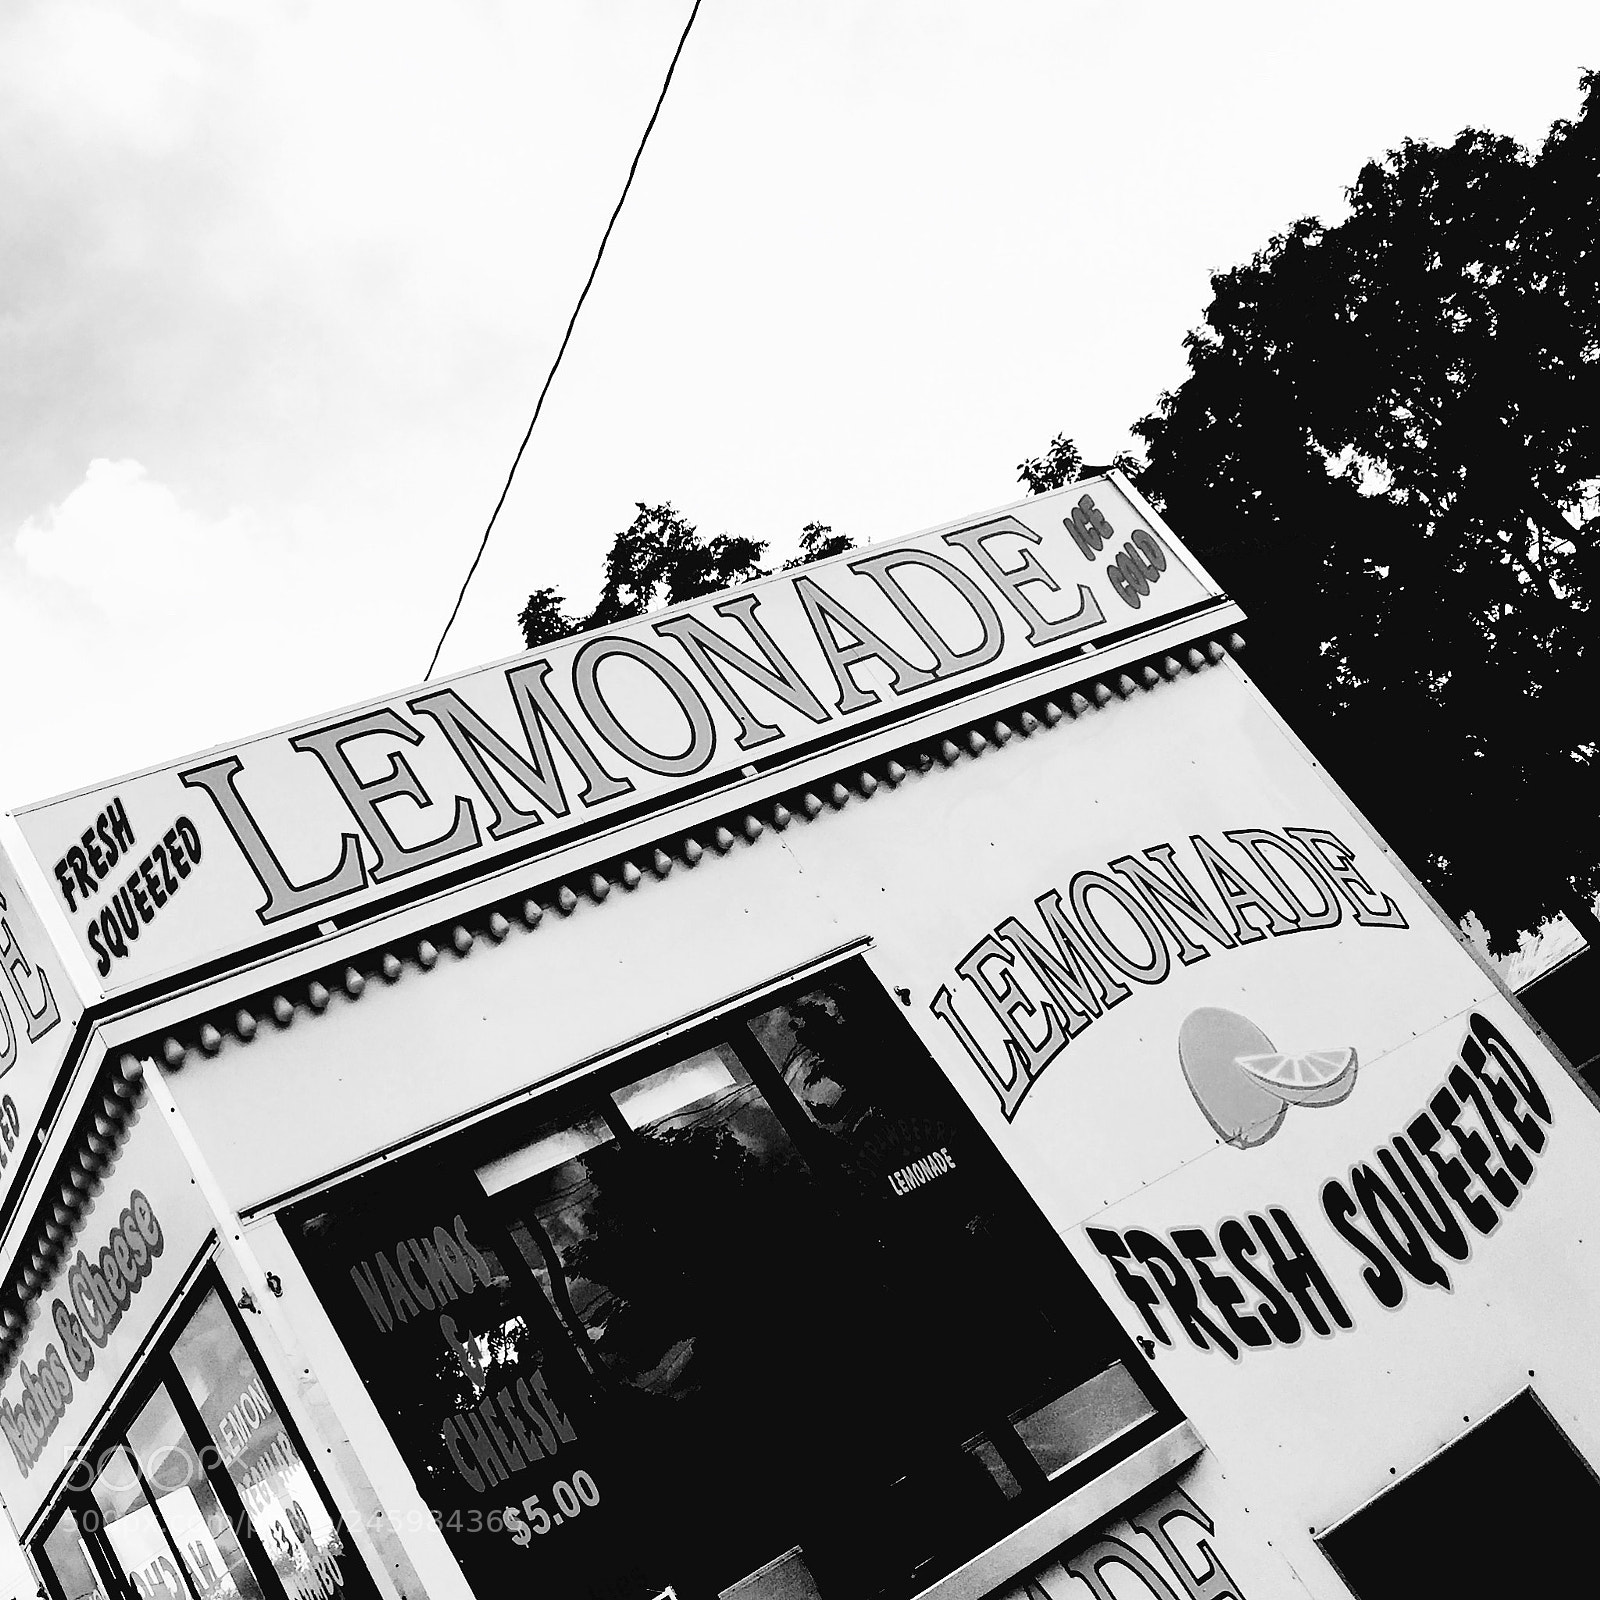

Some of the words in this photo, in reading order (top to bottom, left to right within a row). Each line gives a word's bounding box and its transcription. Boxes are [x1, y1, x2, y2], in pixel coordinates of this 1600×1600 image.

[1063, 494, 1114, 561] ICE
[1107, 529, 1167, 609] COLD
[178, 515, 1107, 926] LEMONADE
[53, 796, 136, 913] FRESH
[87, 816, 202, 977] SQUEEZED
[930, 827, 1409, 1124] LEMONADE
[888, 1147, 956, 1195] LEMONADE
[1084, 1207, 1354, 1361] FRESH
[1319, 1012, 1554, 1311] SQUEEZED
[68, 1189, 164, 1348] Cheese
[349, 1215, 491, 1333] NACHOS
[52, 1298, 95, 1382] &
[0, 1342, 73, 1479] Nachos
[212, 1377, 273, 1467] LEMON
[443, 1369, 577, 1492] CHEESE
[502, 1469, 600, 1548] $5.00
